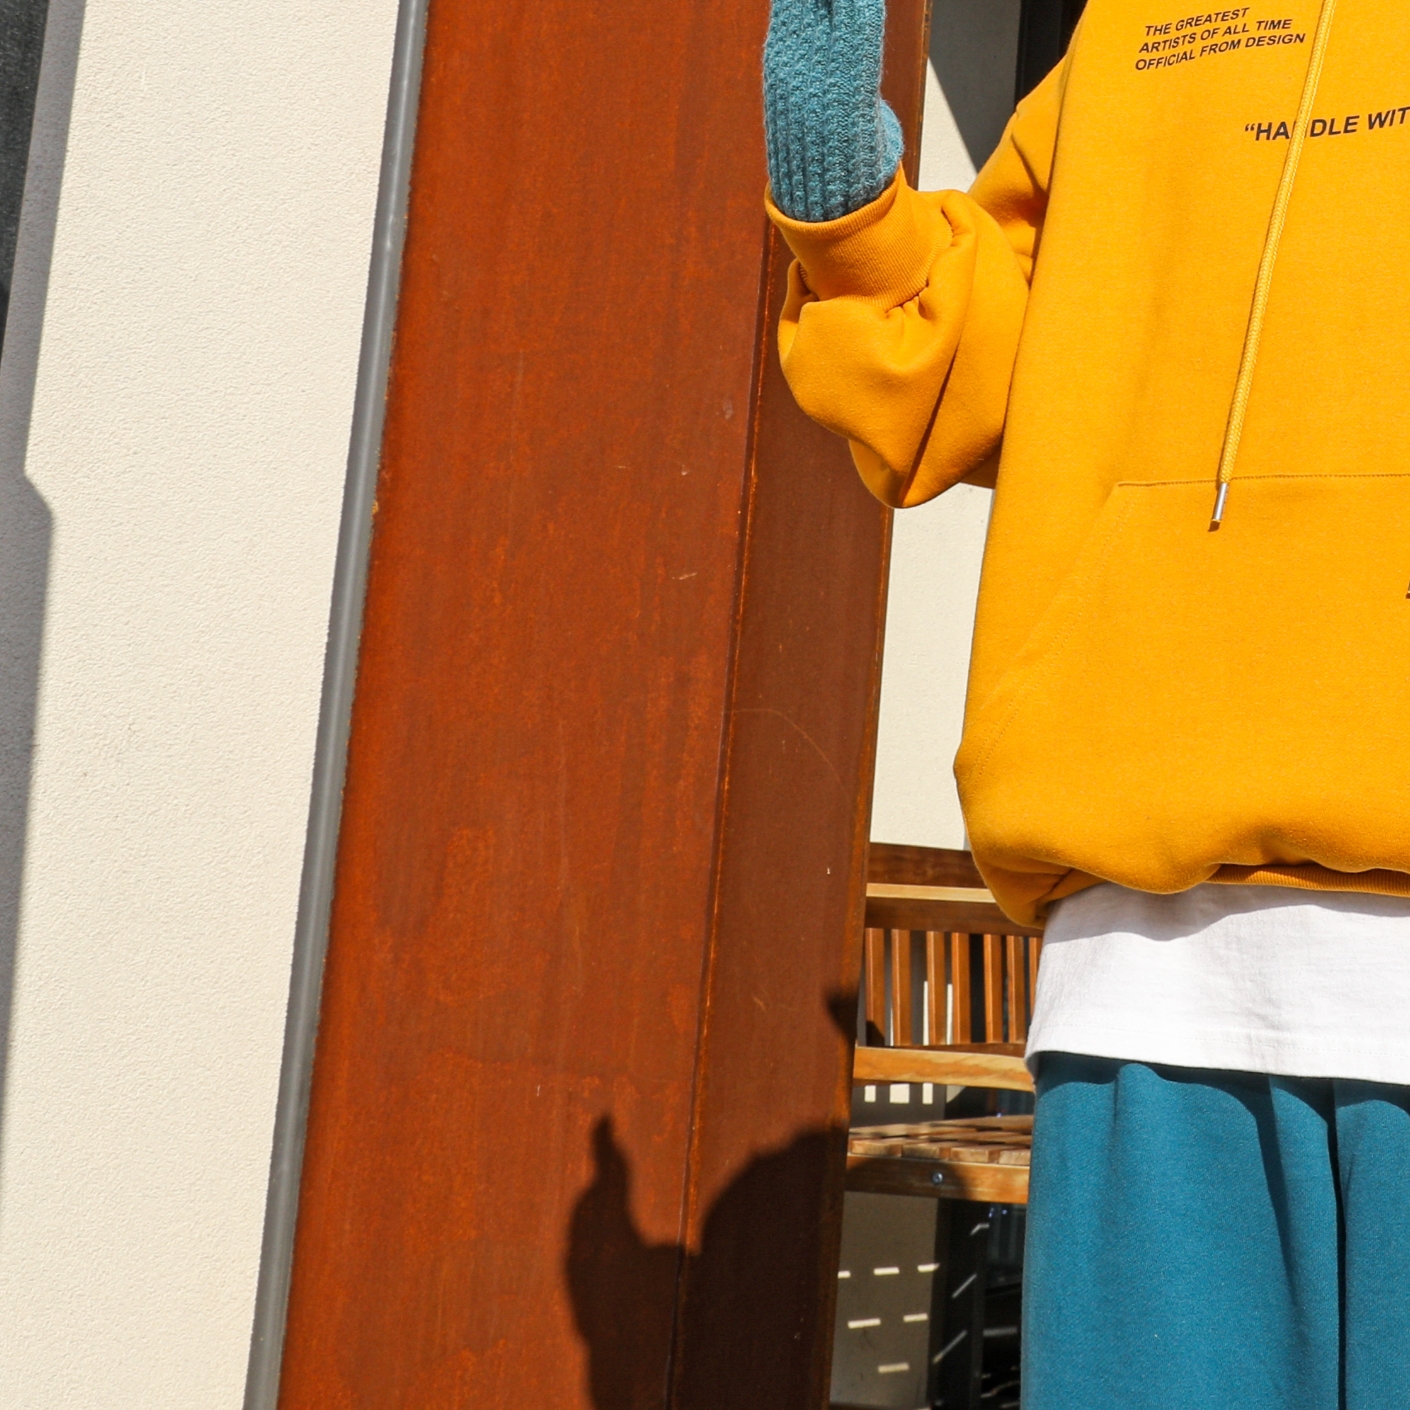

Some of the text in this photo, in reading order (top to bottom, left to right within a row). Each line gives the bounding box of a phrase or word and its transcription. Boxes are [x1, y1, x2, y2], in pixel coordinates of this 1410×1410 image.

[1138, 18, 1293, 54] ARTISTS OF ALL TIME
[1145, 7, 1250, 37] THE GREATEST
[1135, 33, 1307, 71] OFFICIAL FROM DESIGN
[1244, 115, 1360, 141] “HADLE
